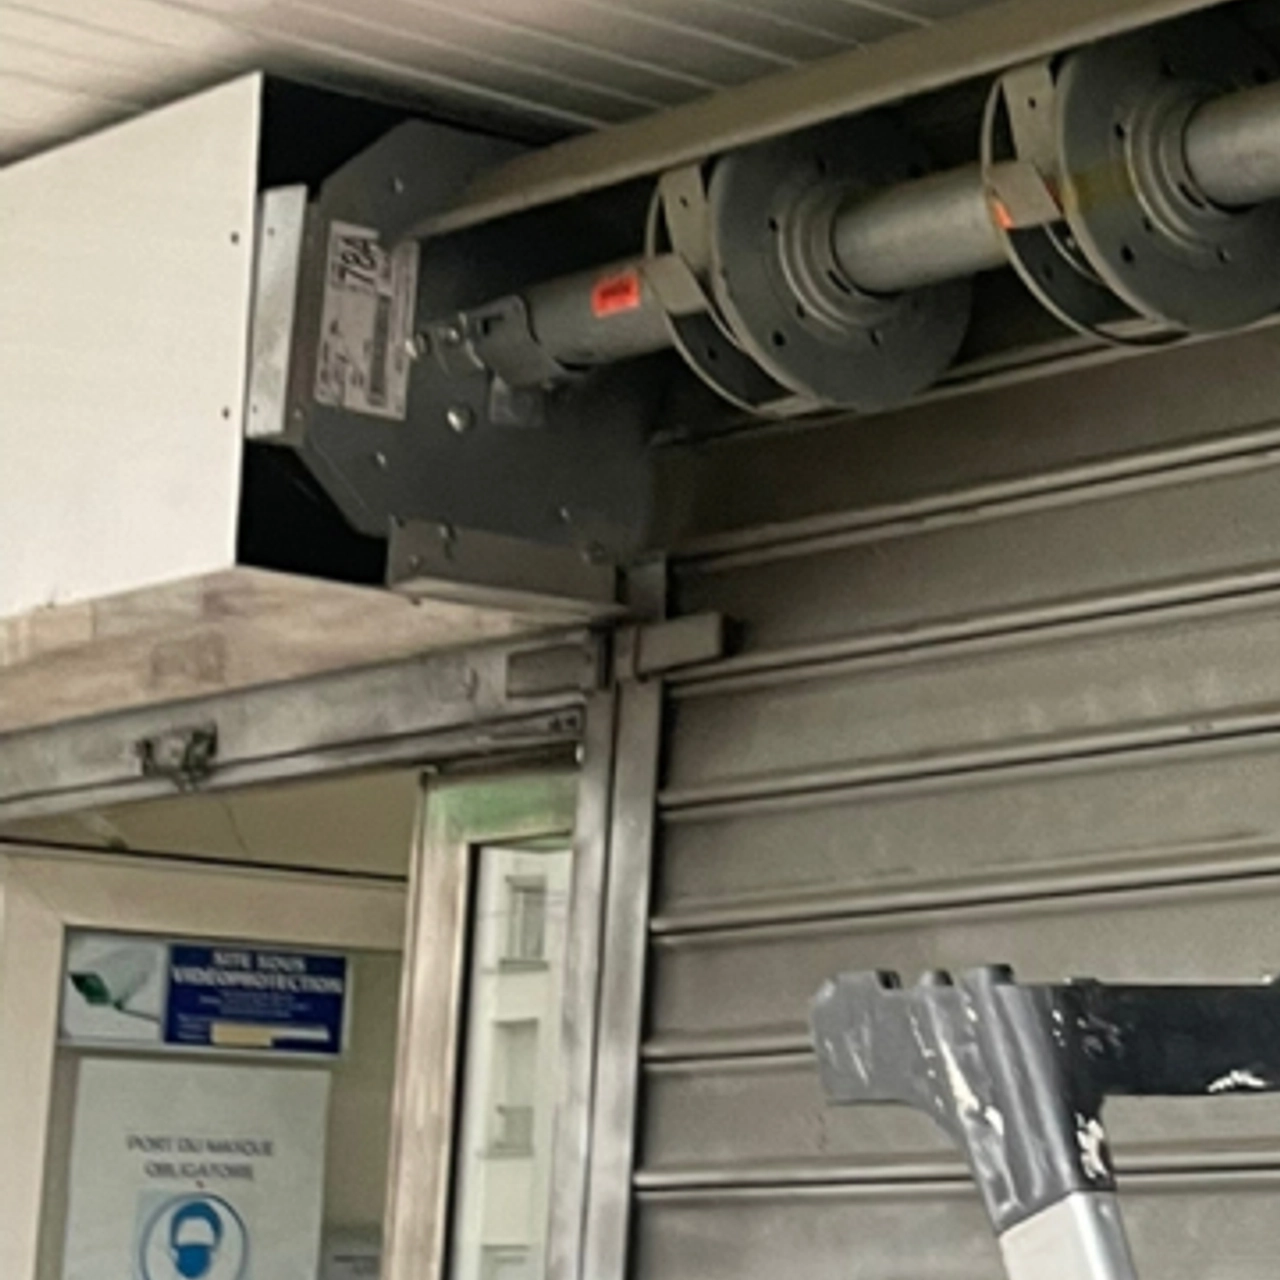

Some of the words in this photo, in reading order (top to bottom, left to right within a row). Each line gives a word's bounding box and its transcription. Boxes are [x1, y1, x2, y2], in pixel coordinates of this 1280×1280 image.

[212, 951, 250, 968] SITE
[256, 953, 306, 972] SOUS
[126, 1135, 171, 1153] PORT
[177, 1137, 201, 1154] DU
[206, 1139, 273, 1157] MASQUE
